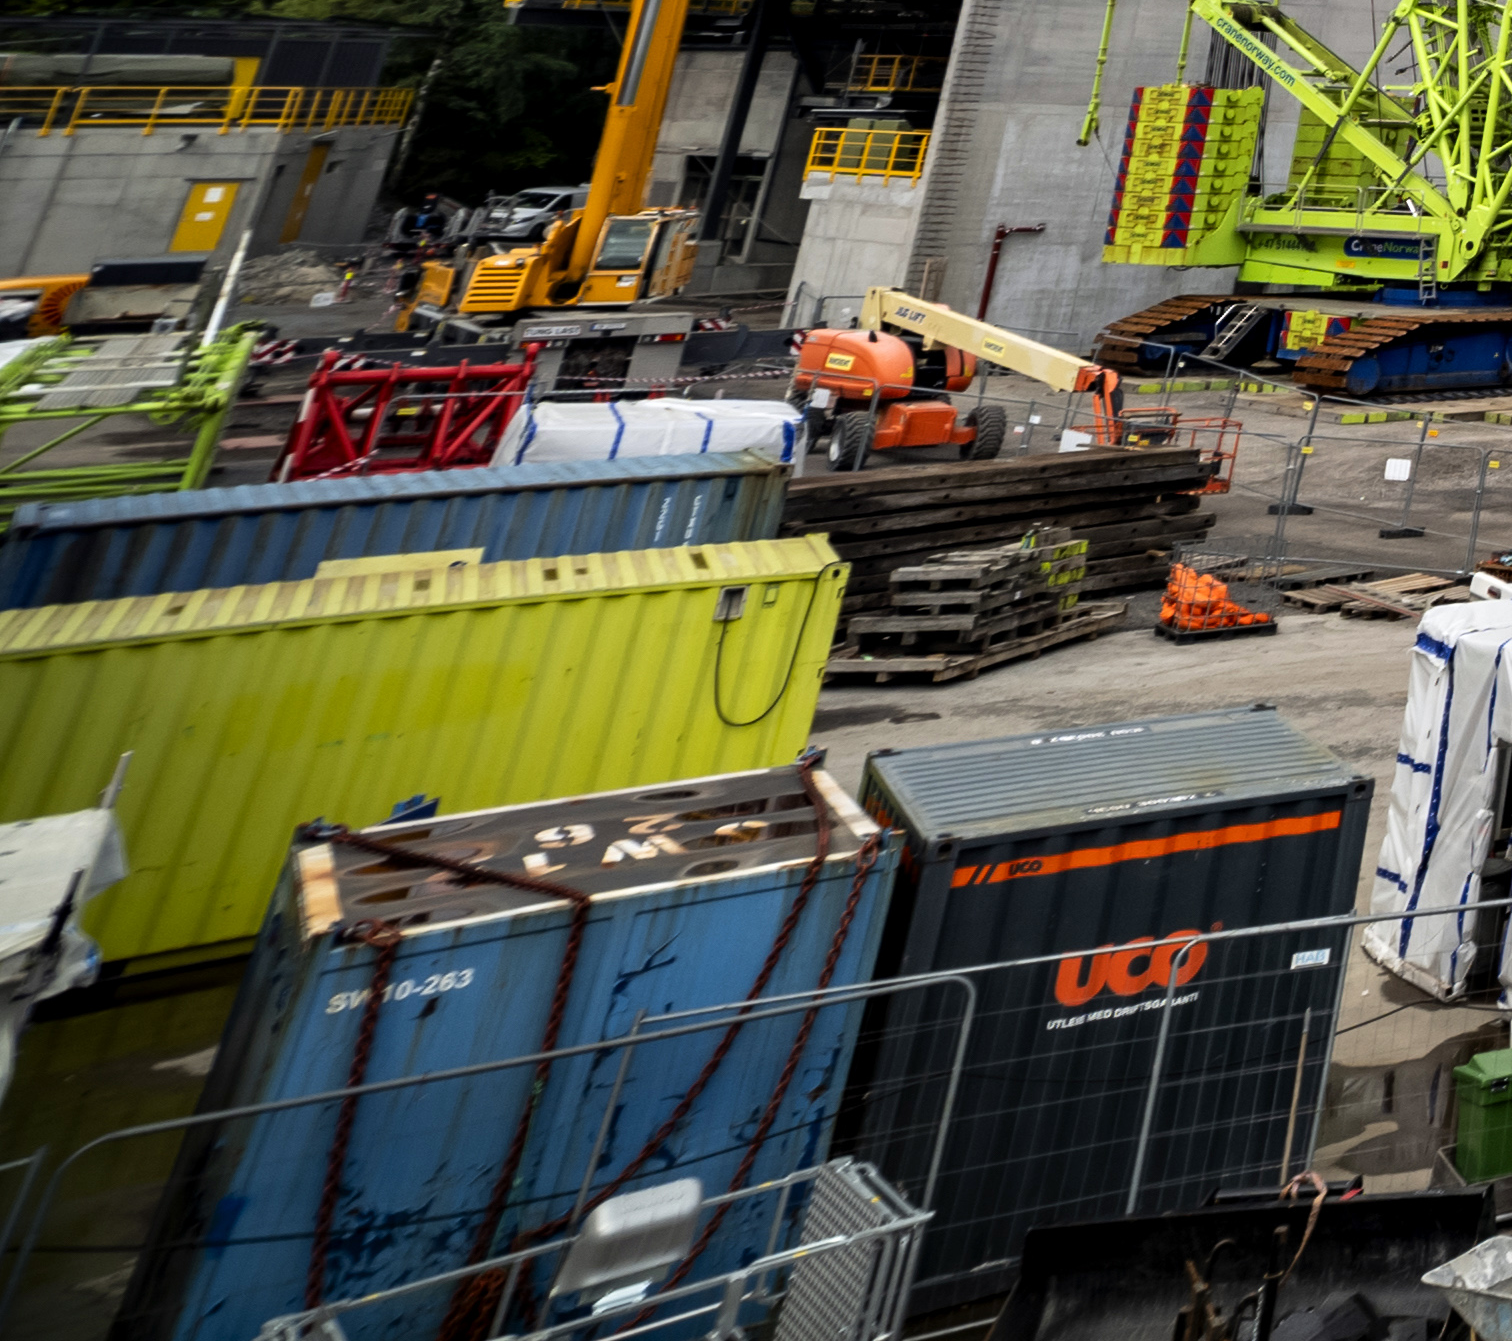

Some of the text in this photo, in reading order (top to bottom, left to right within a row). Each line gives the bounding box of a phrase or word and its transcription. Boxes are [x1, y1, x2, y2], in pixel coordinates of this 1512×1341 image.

[1216, 17, 1296, 87] cranenorway.com
[1009, 859, 1043, 876] UCO
[1054, 928, 1209, 1007] UCO
[1087, 1008, 1113, 1022] MED
[1113, 991, 1200, 1019] DRIFTSGAANTI
